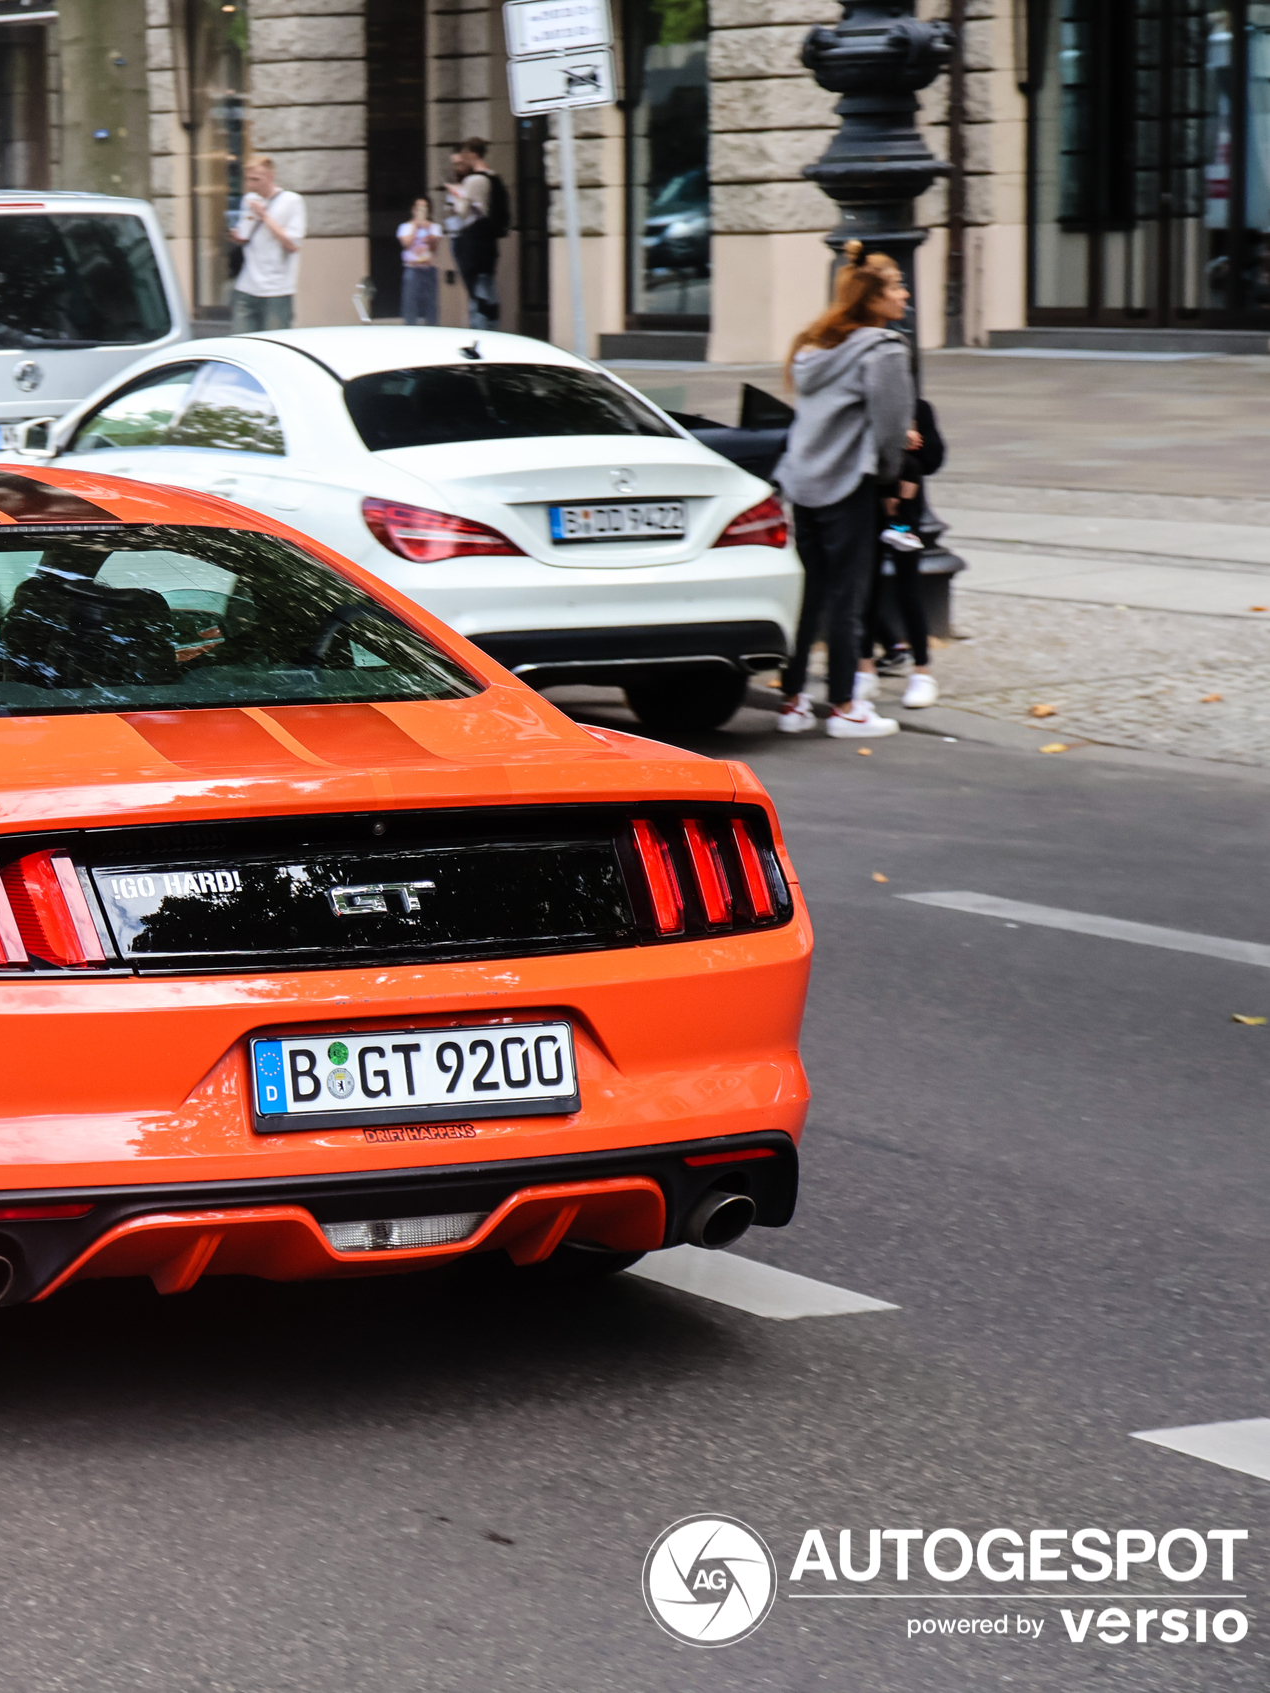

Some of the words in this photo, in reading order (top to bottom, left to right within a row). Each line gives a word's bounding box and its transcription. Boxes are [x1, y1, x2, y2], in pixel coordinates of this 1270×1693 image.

[111, 875, 156, 900] !GO
[164, 871, 242, 896] HARD!
[331, 881, 436, 918] GT
[289, 1049, 321, 1103] B
[358, 1043, 421, 1099] GT
[436, 1035, 563, 1094] 9200
[266, 1086, 278, 1102] D
[363, 1127, 406, 1144] DRIFT
[407, 1124, 476, 1141] HAPPENS
